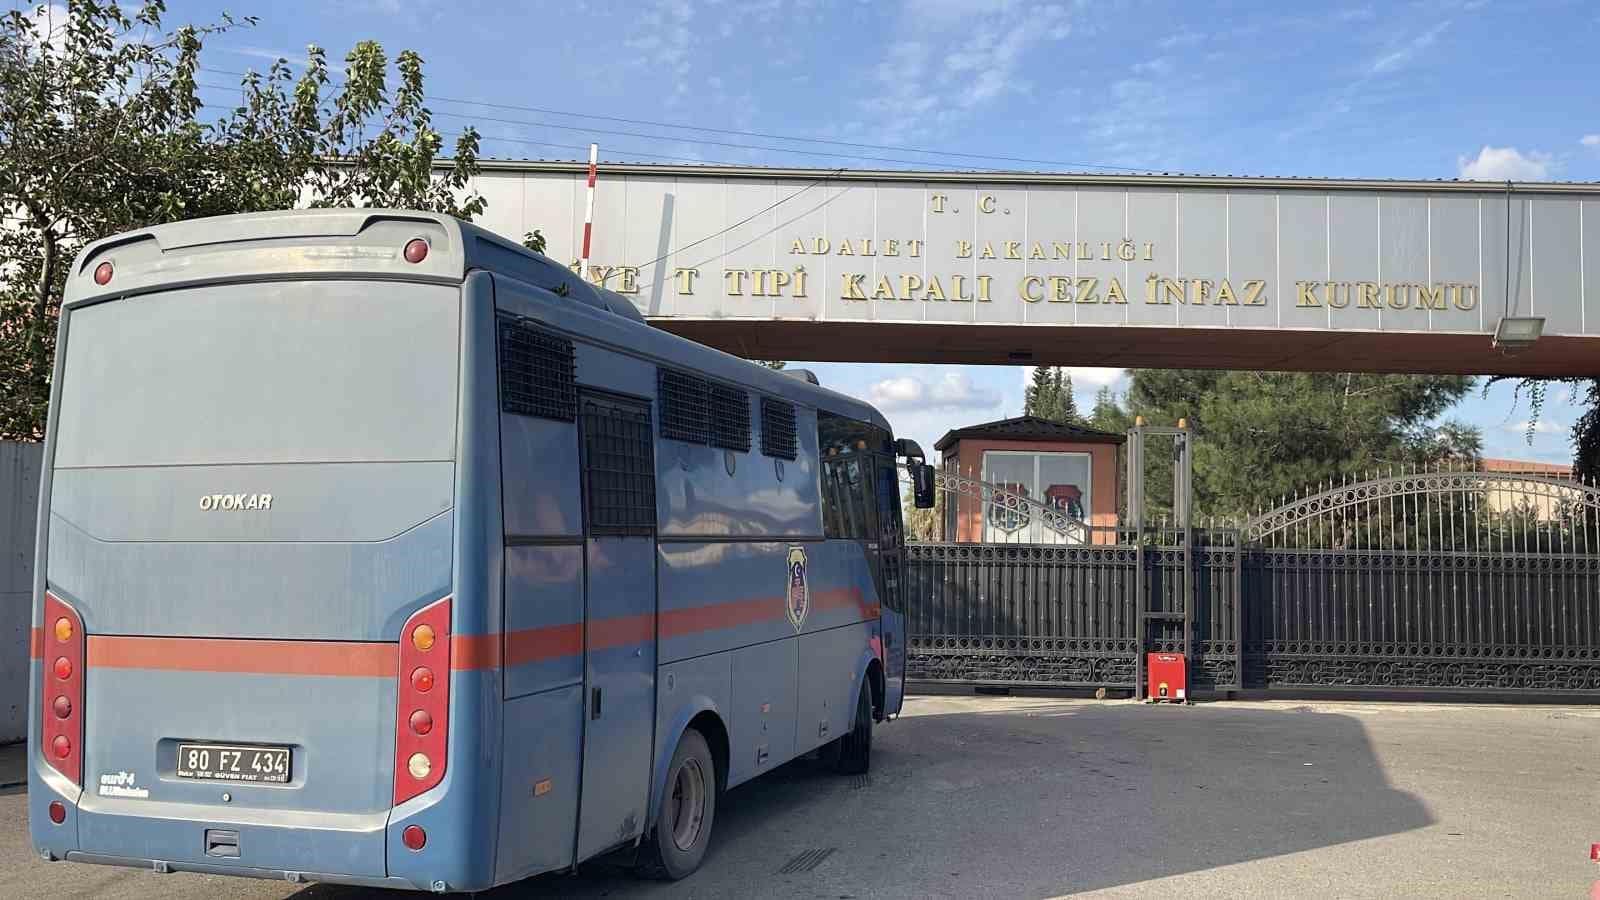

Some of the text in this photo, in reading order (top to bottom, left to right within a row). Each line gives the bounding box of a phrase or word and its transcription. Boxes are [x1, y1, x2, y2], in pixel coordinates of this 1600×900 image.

[932, 194, 1011, 215] T. C.
[789, 235, 1154, 262] ADALET BAKANLIĞI
[674, 266, 701, 296] T
[841, 271, 993, 302] KAPALI
[1018, 274, 1129, 305] CEZA
[1144, 272, 1268, 306] İNFAZ
[1295, 280, 1479, 310] KURUMU
[199, 493, 273, 510] OTOKAR
[188, 749, 285, 773] 80 FZ 434
